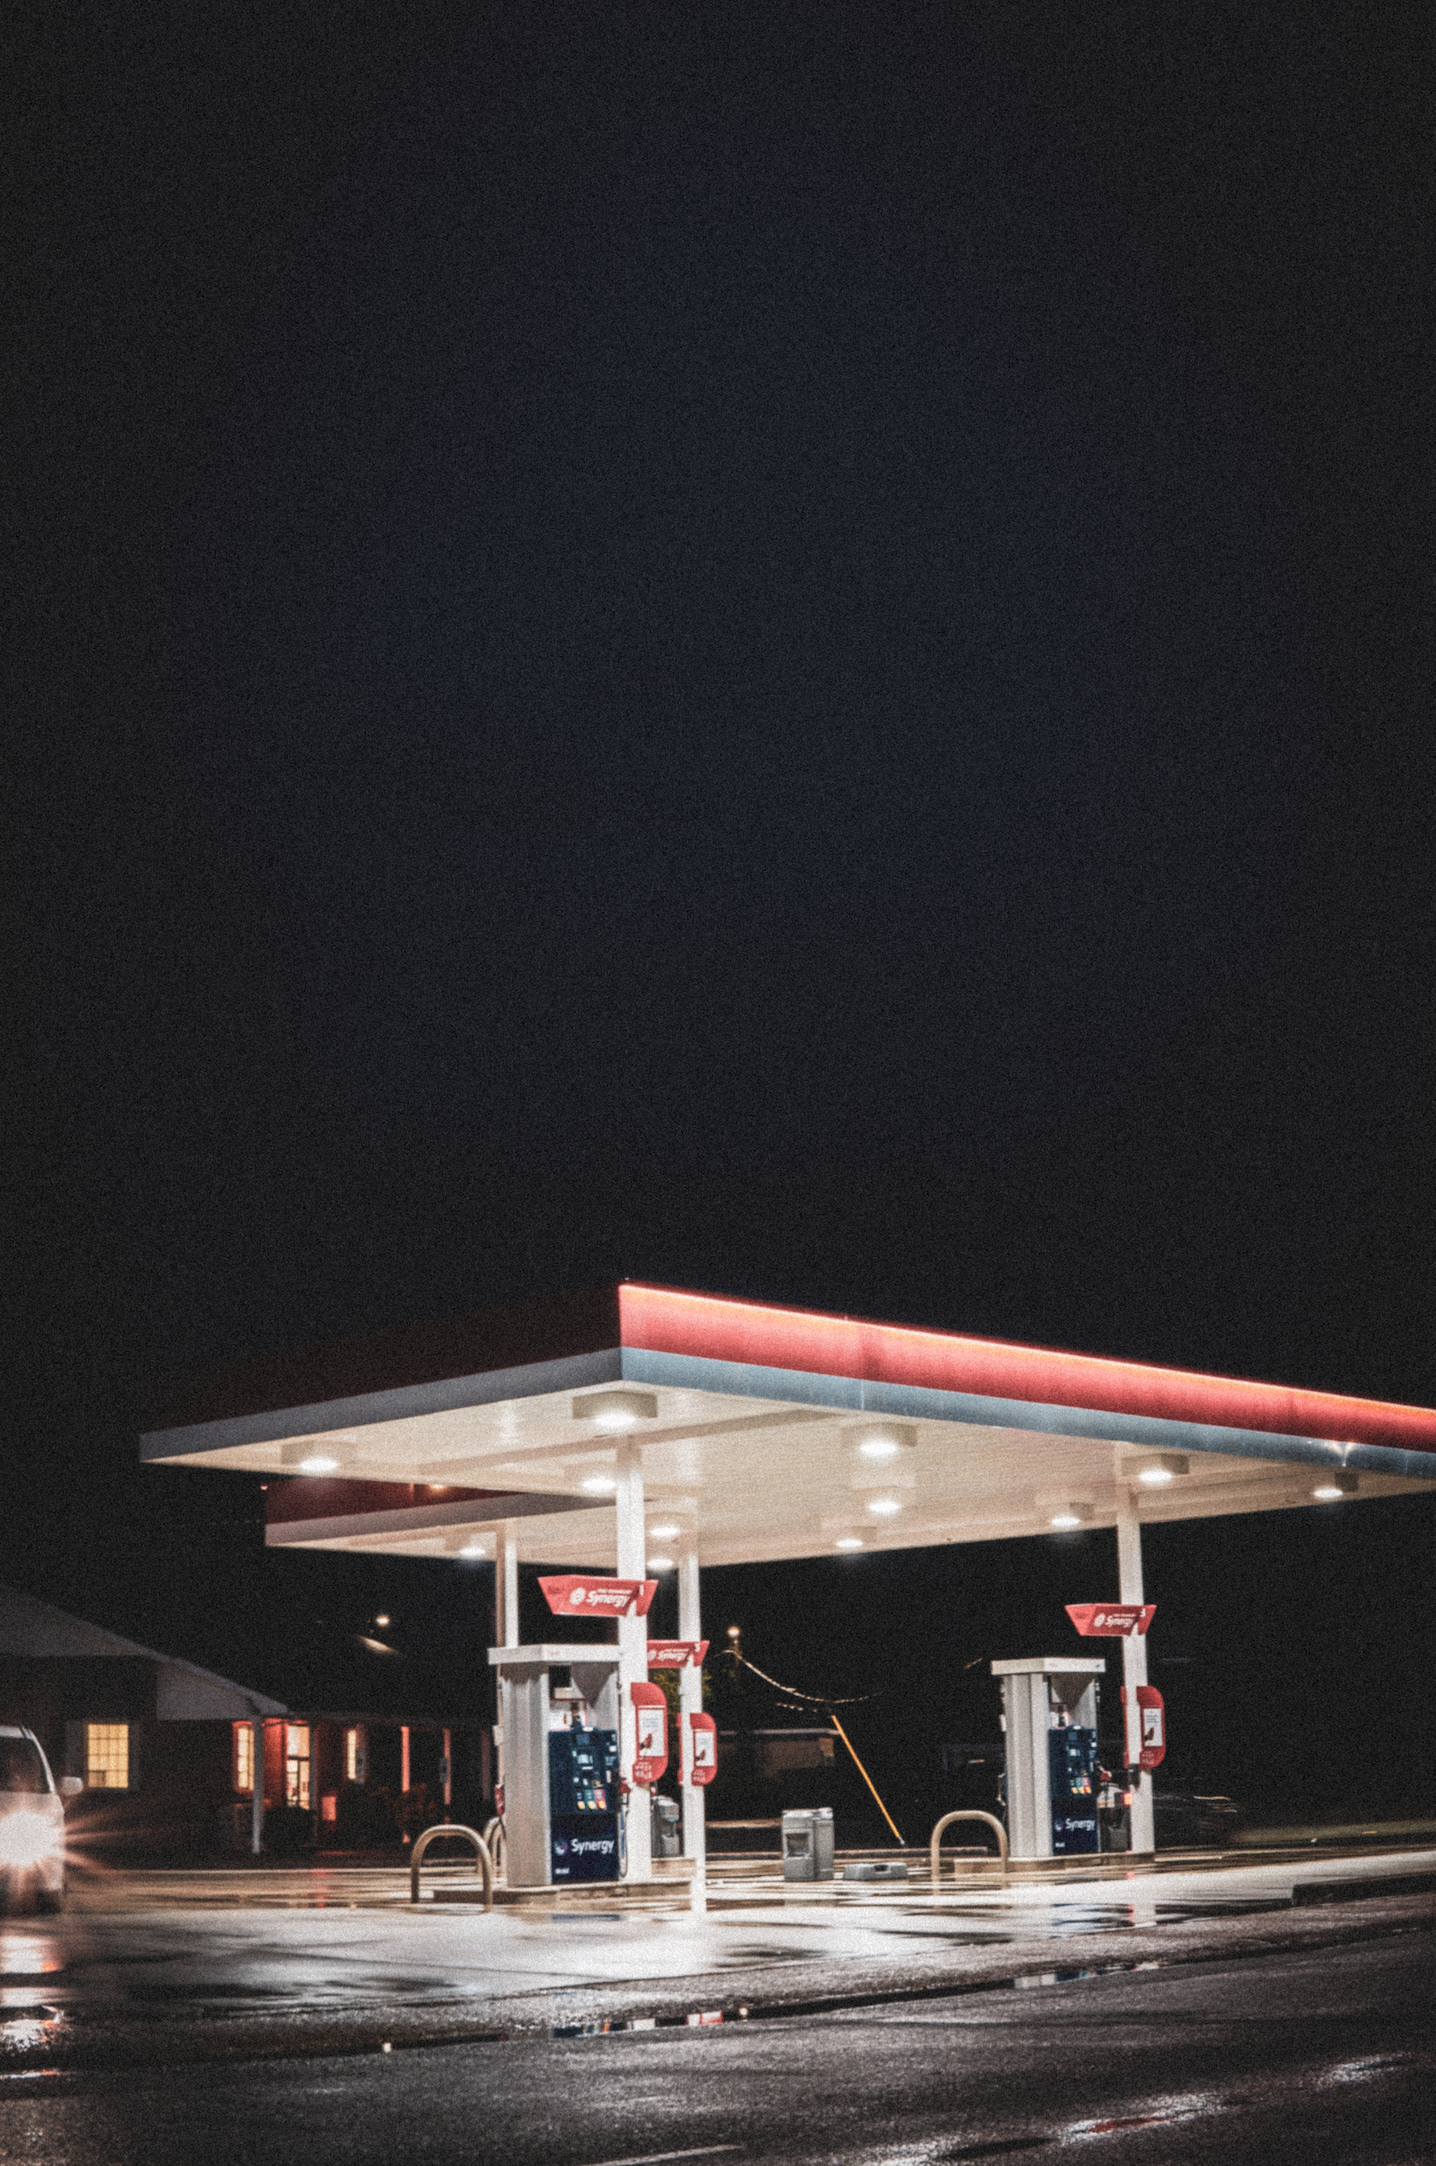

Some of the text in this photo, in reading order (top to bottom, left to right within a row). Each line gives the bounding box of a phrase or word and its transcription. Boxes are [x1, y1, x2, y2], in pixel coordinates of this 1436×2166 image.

[585, 1590, 630, 1607] Synergy
[1105, 1615, 1133, 1628] Synergy
[656, 1651, 687, 1662] Synergy
[1065, 1818, 1096, 1832] Synergy
[571, 1838, 615, 1856] Synergy
